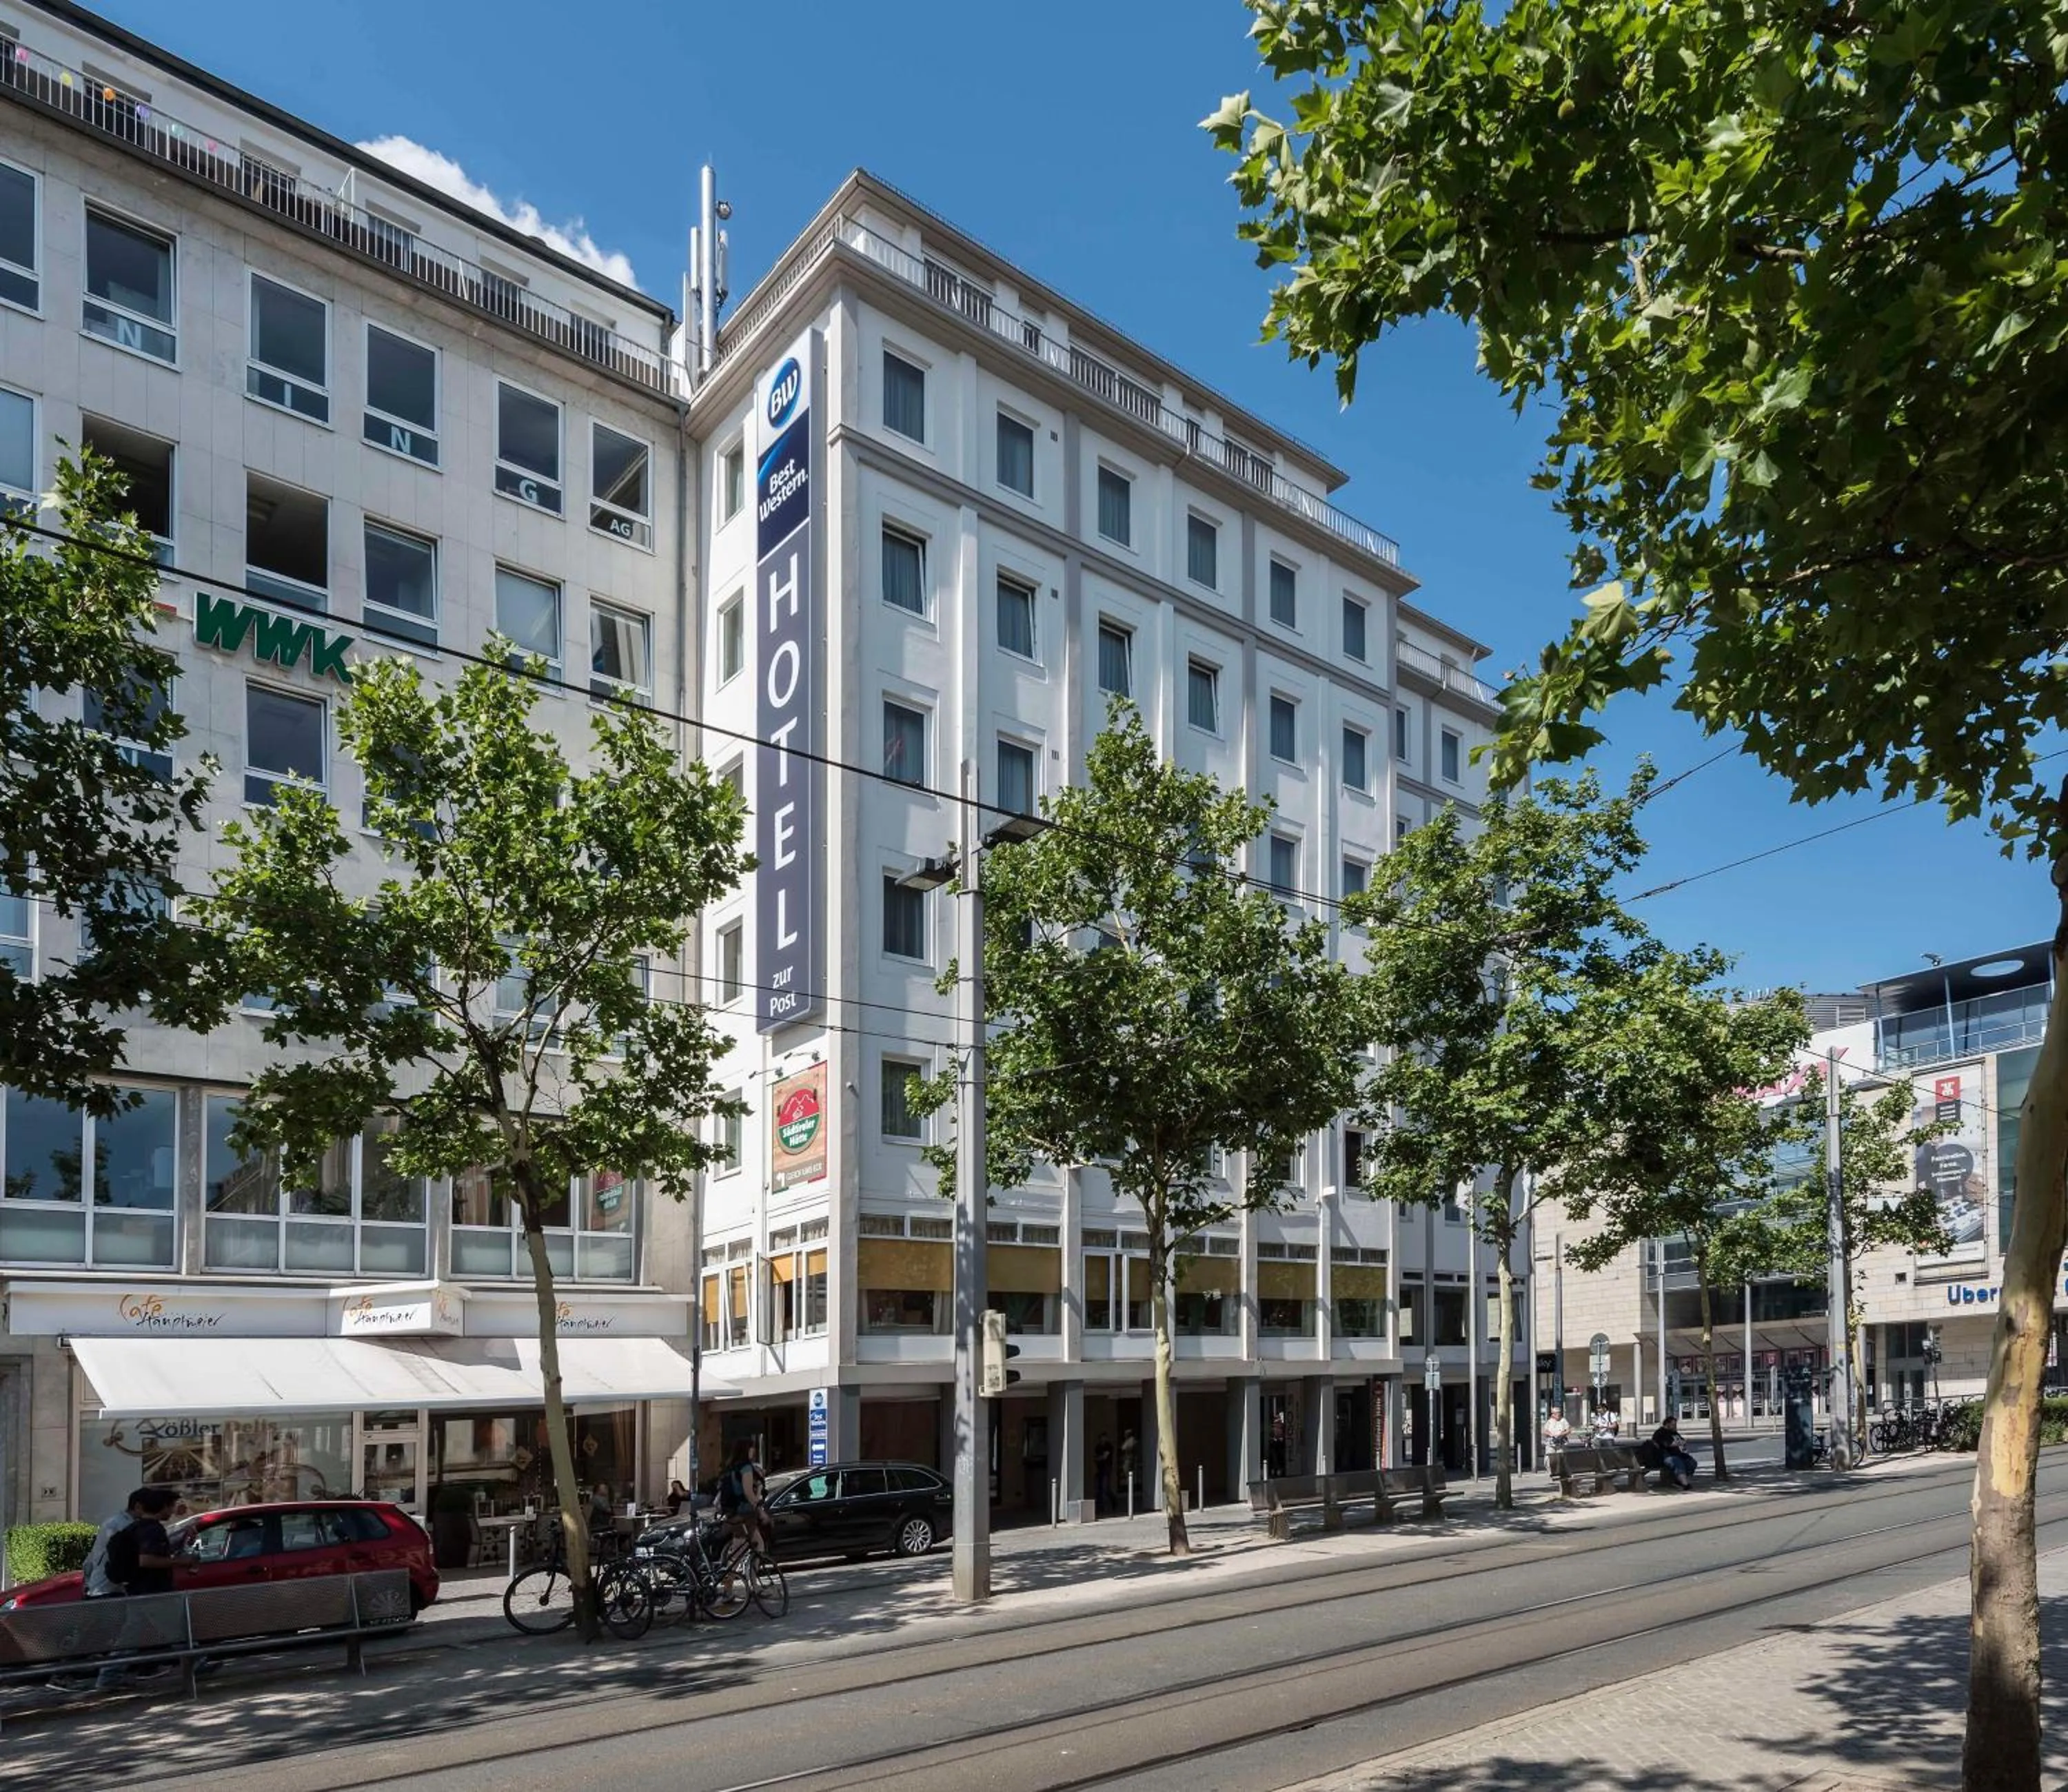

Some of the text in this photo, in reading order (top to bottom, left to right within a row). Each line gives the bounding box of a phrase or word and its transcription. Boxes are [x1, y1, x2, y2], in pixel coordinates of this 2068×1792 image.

[771, 369, 798, 419] BW
[769, 458, 795, 495] Best
[610, 518, 631, 536] AG
[194, 592, 354, 684] WWK
[767, 551, 800, 950] HOTEL
[773, 966, 793, 989] zur
[769, 990, 796, 1017] Post
